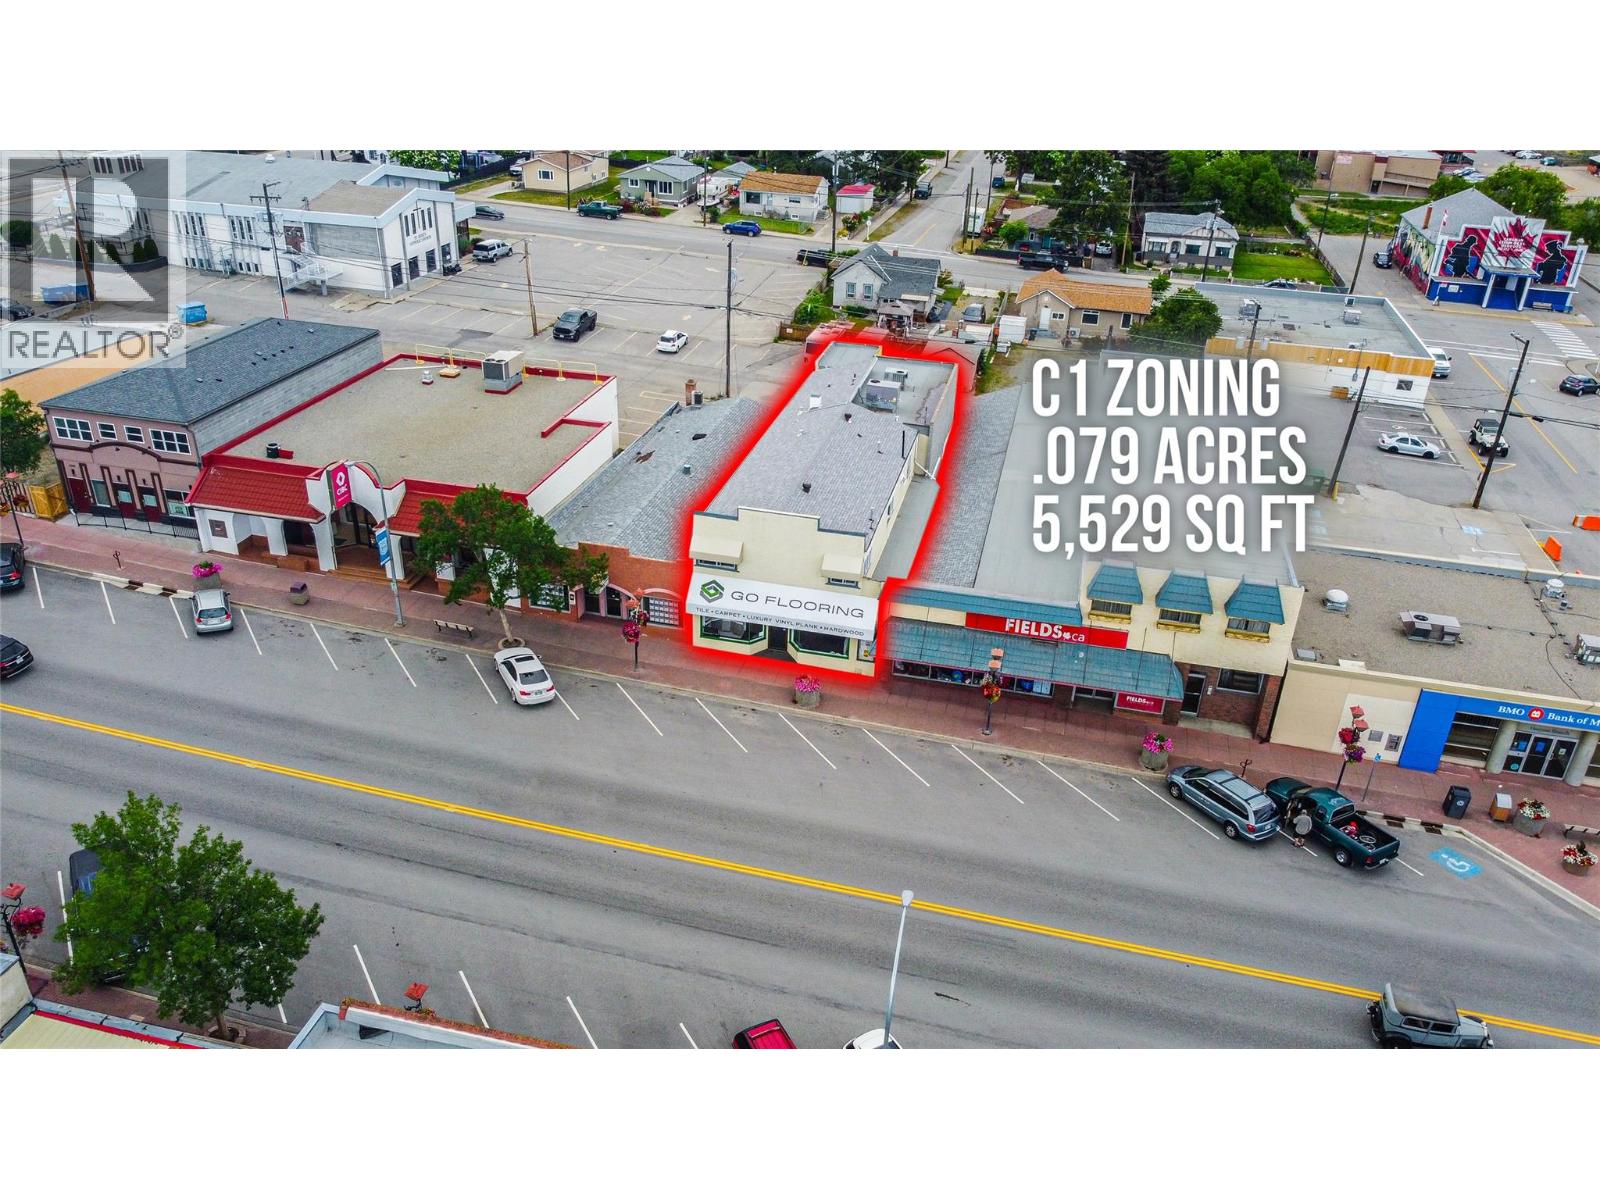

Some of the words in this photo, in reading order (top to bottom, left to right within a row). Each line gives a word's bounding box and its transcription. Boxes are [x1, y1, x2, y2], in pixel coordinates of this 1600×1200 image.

[731, 591, 759, 602] GO
[765, 595, 864, 619] FLOORING
[714, 609, 741, 618] CARPET
[746, 614, 772, 623] LUXURY
[775, 618, 795, 627] VINYL
[823, 626, 865, 637] HARDWOOD
[1498, 705, 1525, 716] BMO
[1547, 712, 1574, 723] Bank
[1576, 717, 1589, 725] of
